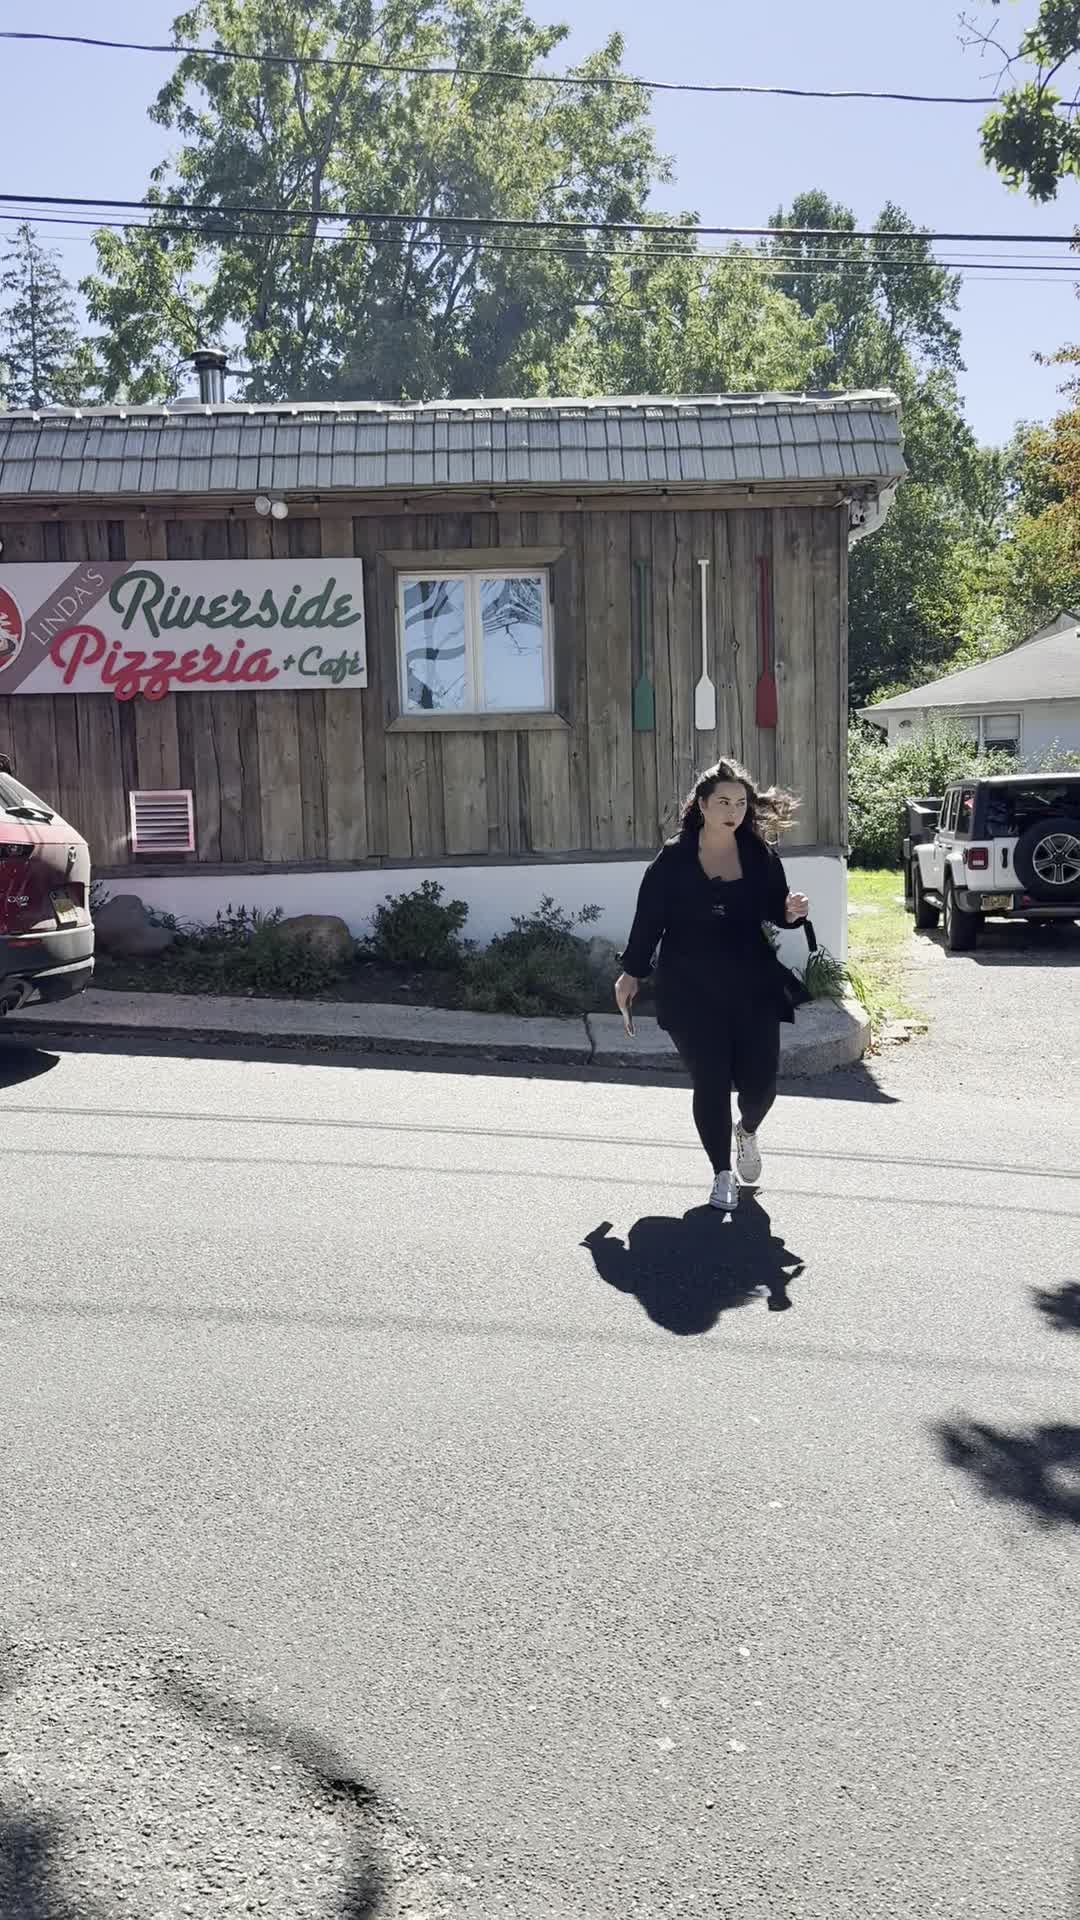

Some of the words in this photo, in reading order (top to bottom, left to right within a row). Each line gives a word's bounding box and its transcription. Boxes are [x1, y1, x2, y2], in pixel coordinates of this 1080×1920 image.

[31, 568, 104, 645] LINDA'S
[109, 569, 361, 638] Riverside
[50, 624, 279, 701] Pizzeria
